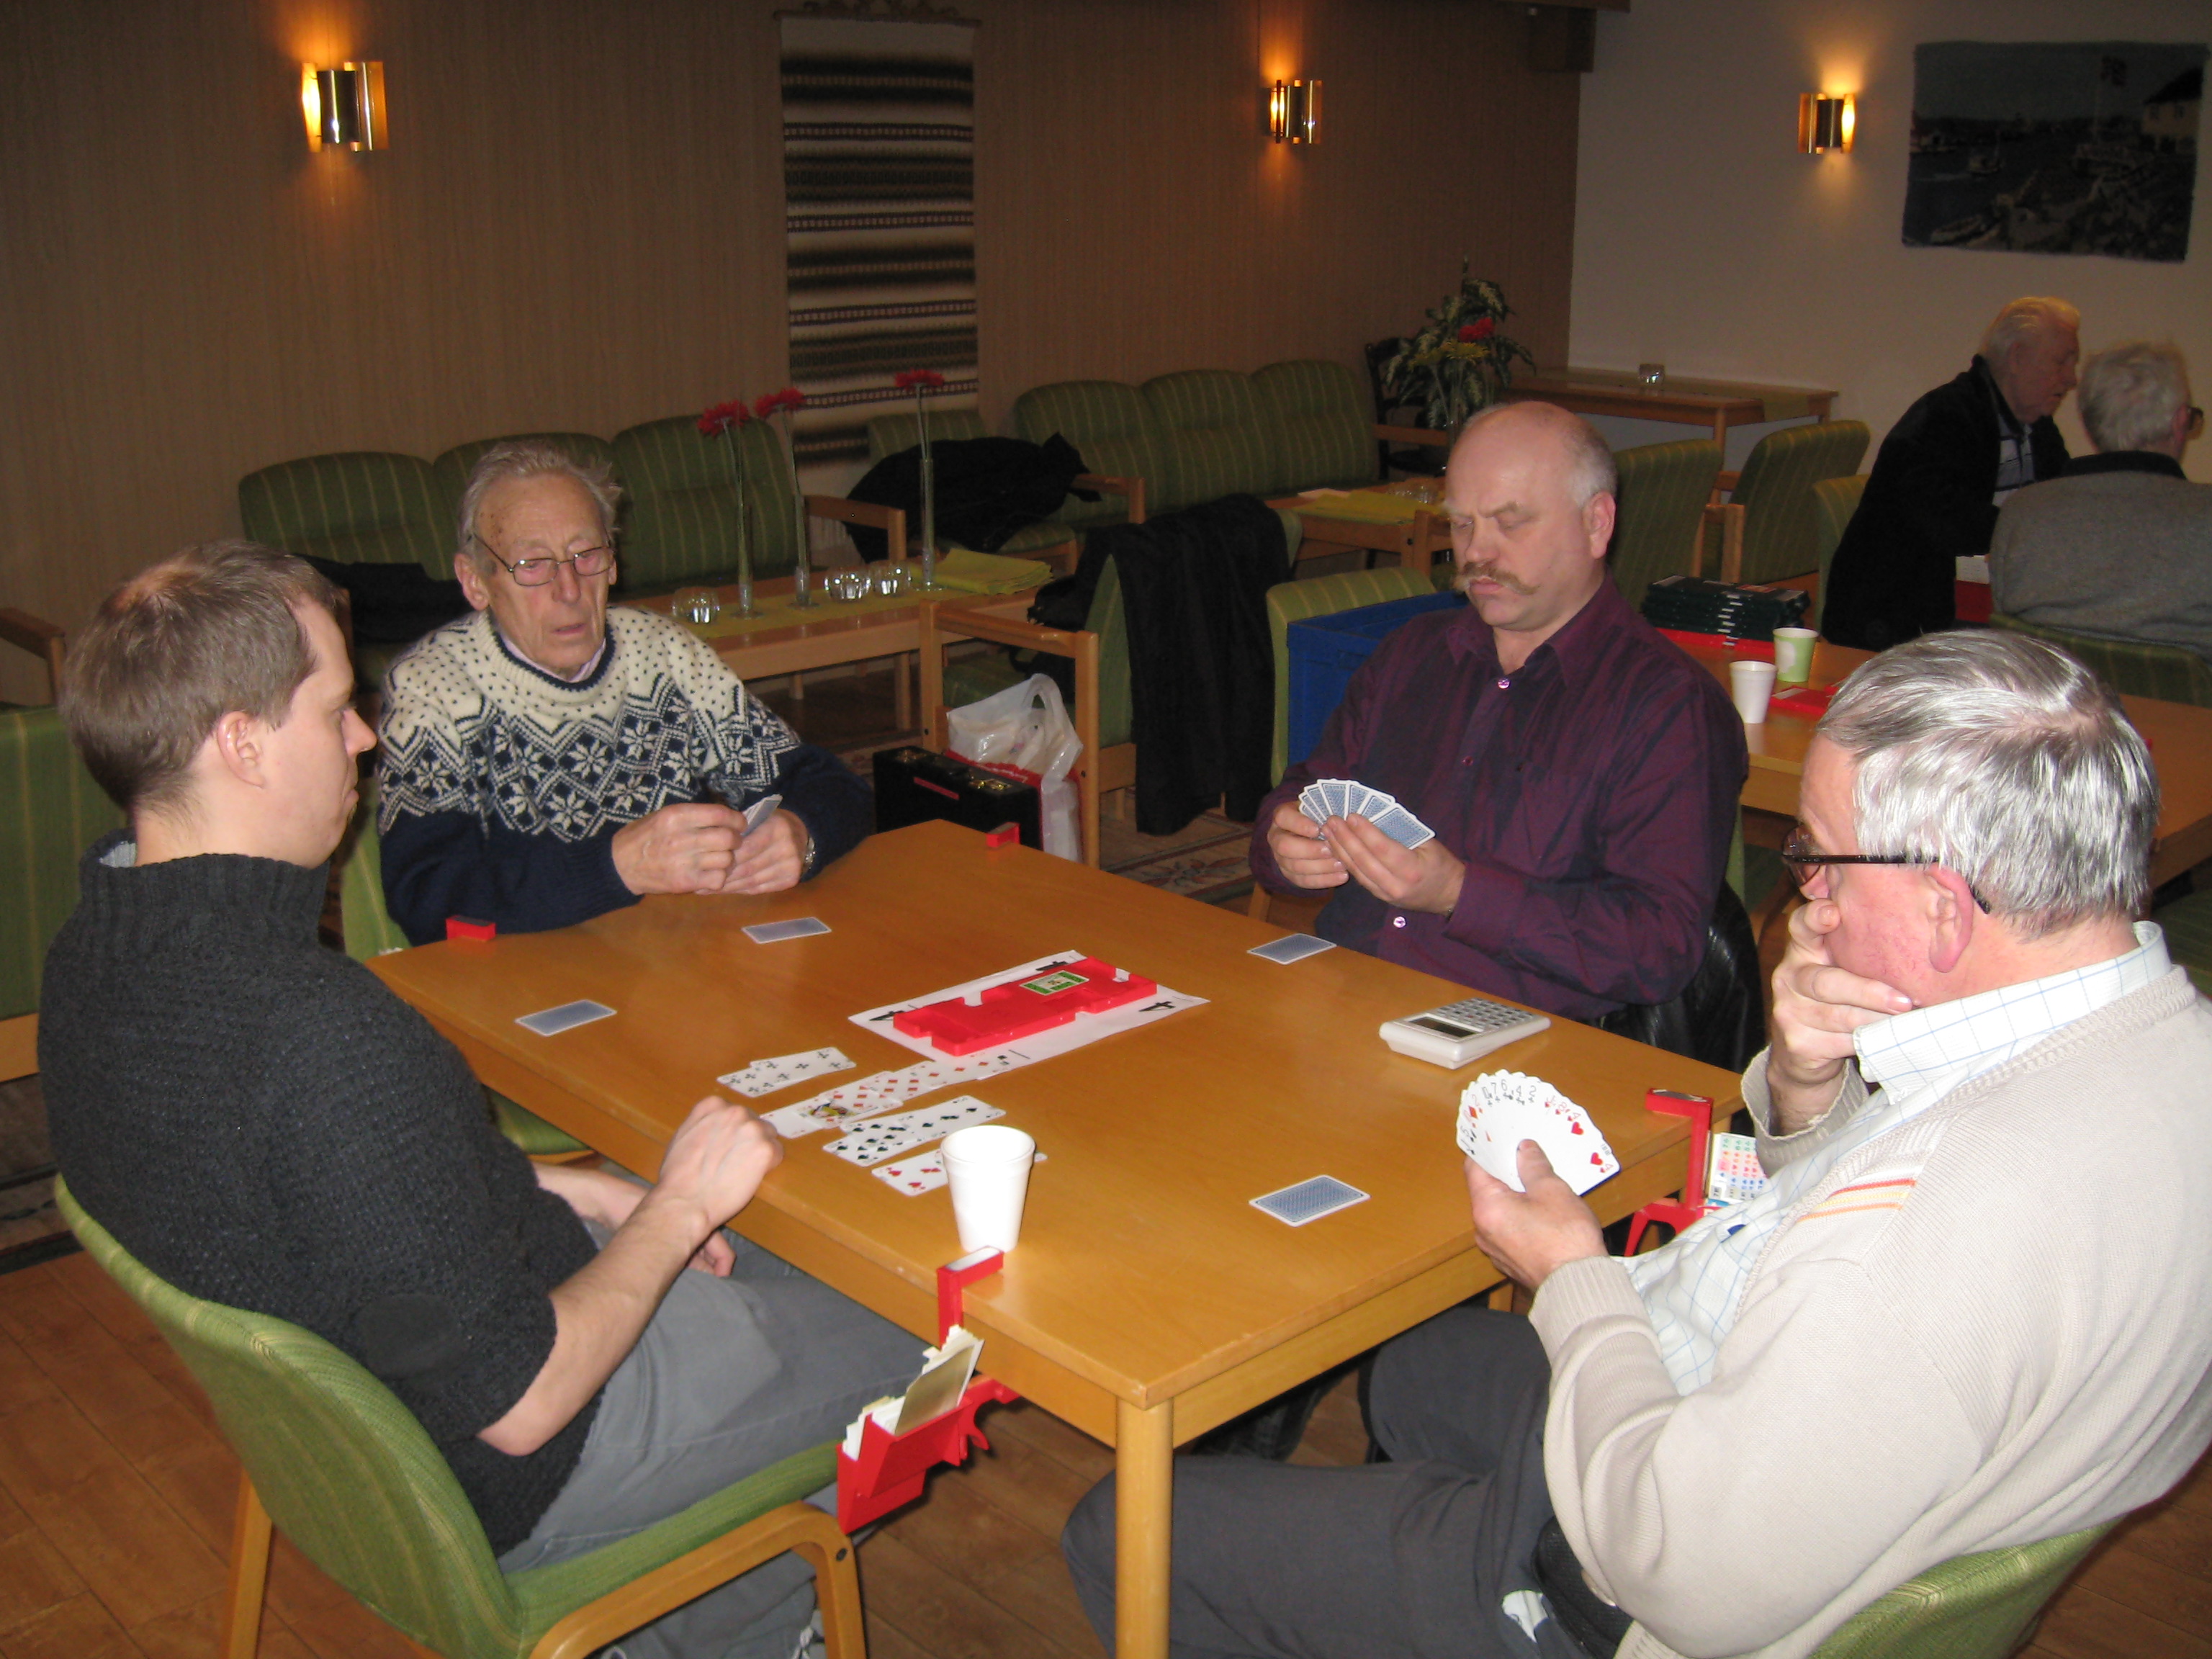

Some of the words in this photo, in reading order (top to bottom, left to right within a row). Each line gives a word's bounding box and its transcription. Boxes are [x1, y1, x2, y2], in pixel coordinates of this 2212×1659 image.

[1491, 1082, 1497, 1094] 7
[1501, 1079, 1508, 1092] 6
[1516, 1085, 1522, 1097] 4
[1529, 1085, 1537, 1097] 2
